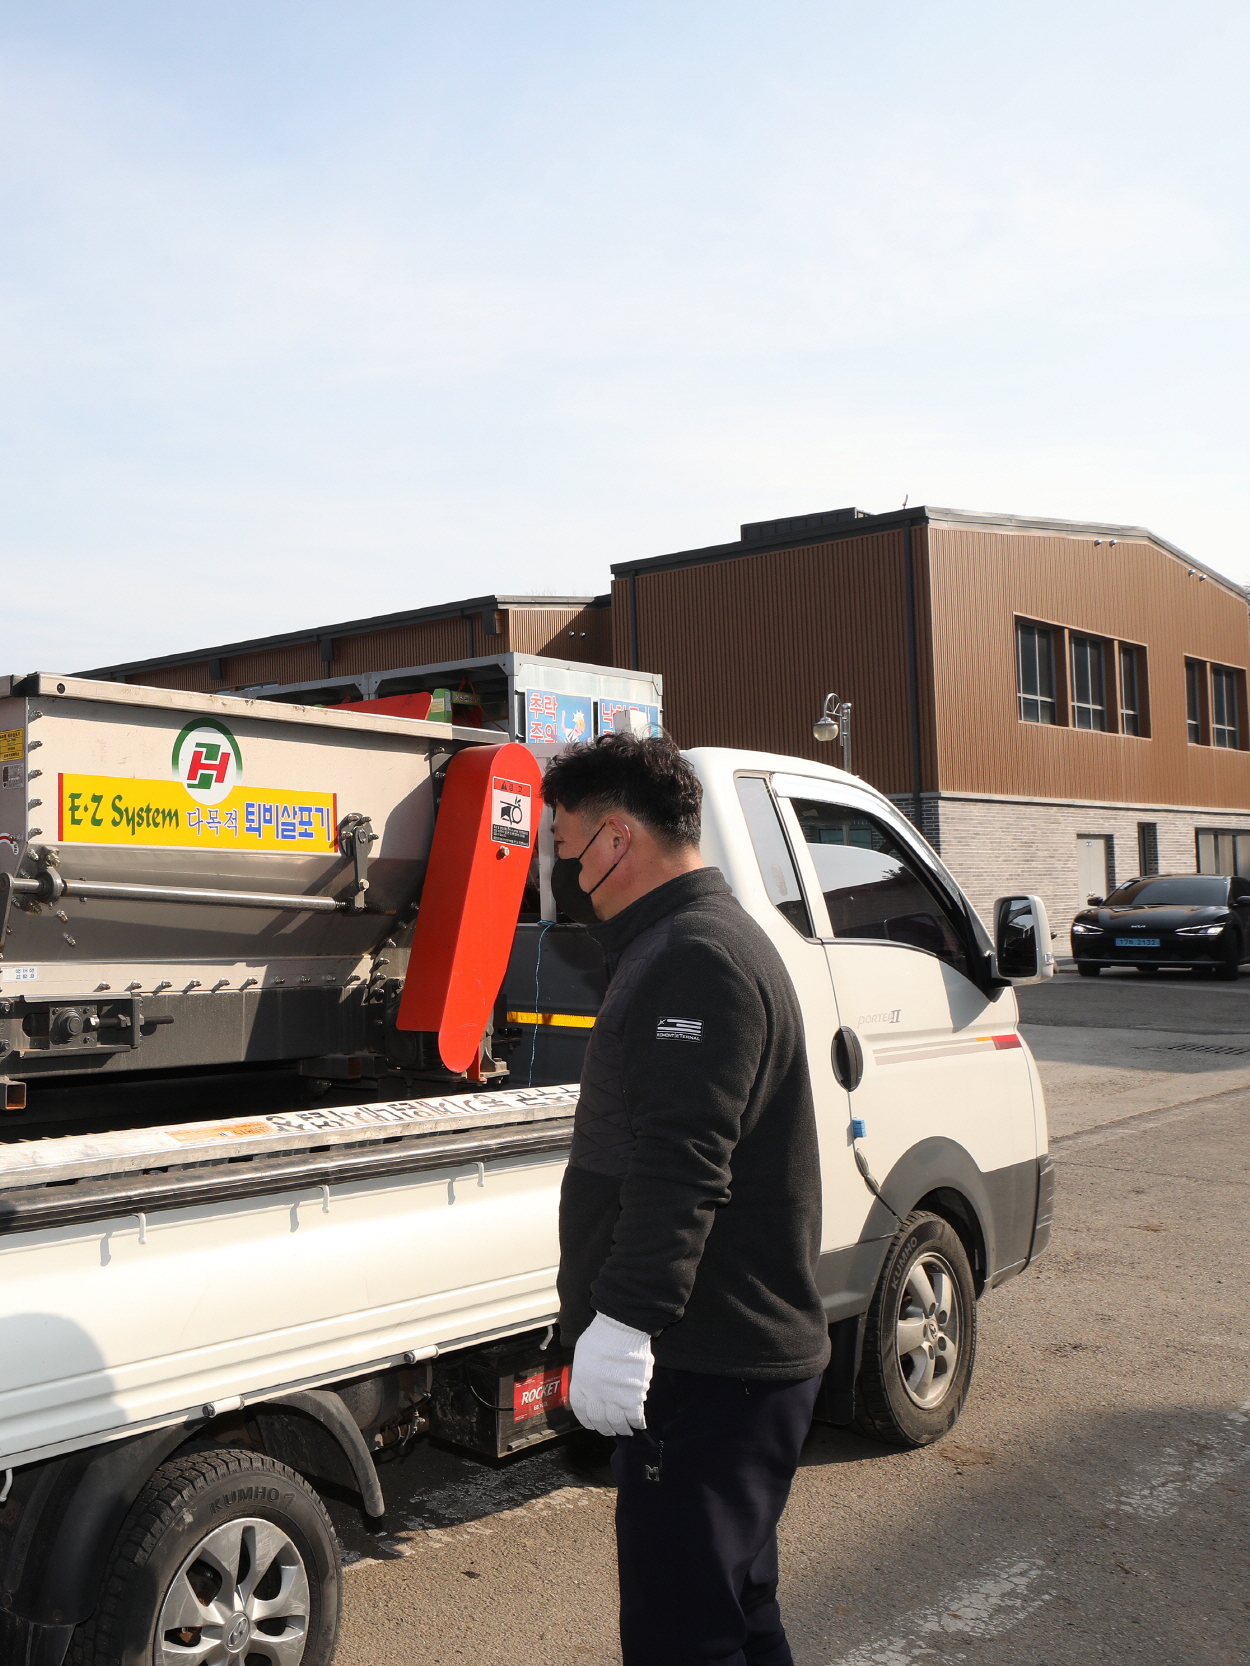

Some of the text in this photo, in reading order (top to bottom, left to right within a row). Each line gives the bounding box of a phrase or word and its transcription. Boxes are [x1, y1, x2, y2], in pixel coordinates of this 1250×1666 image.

[529, 693, 558, 721] 추락
[530, 721, 558, 743] 주의
[111, 795, 180, 836] System
[186, 806, 239, 837] 다목적
[244, 802, 331, 842] 퇴비살포기
[891, 1237, 917, 1290] KUMHO
[521, 1380, 560, 1406] ROCKET
[209, 1486, 280, 1516] KUMHO
